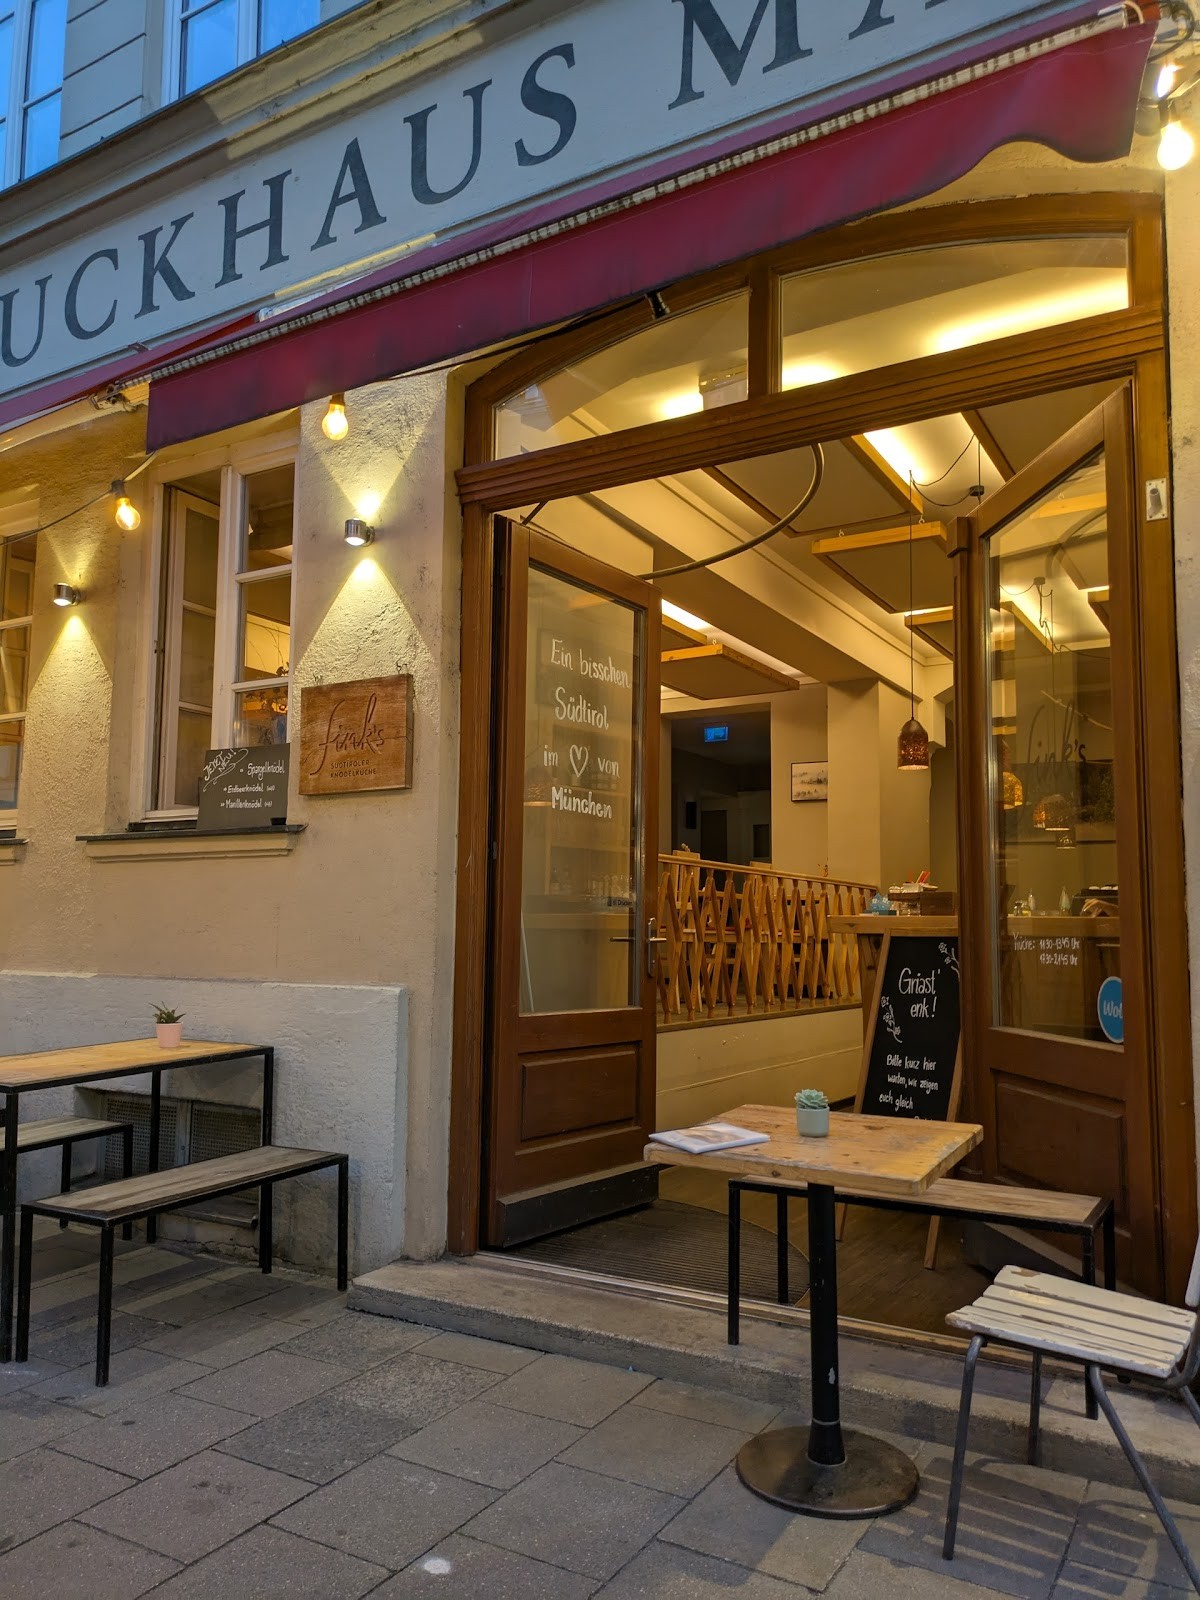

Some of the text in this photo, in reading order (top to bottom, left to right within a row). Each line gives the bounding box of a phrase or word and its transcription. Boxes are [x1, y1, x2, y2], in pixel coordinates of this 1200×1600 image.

[551, 638, 632, 690] Ein bisschen
[555, 686, 610, 730] Südtirol
[543, 744, 621, 778] im von
[551, 786, 613, 819] München
[886, 1054, 937, 1071] Bitte kurz hier
[879, 1090, 914, 1112] euch gleich
[908, 1078, 917, 1087] wir
[920, 1079, 939, 1095] zeigen
